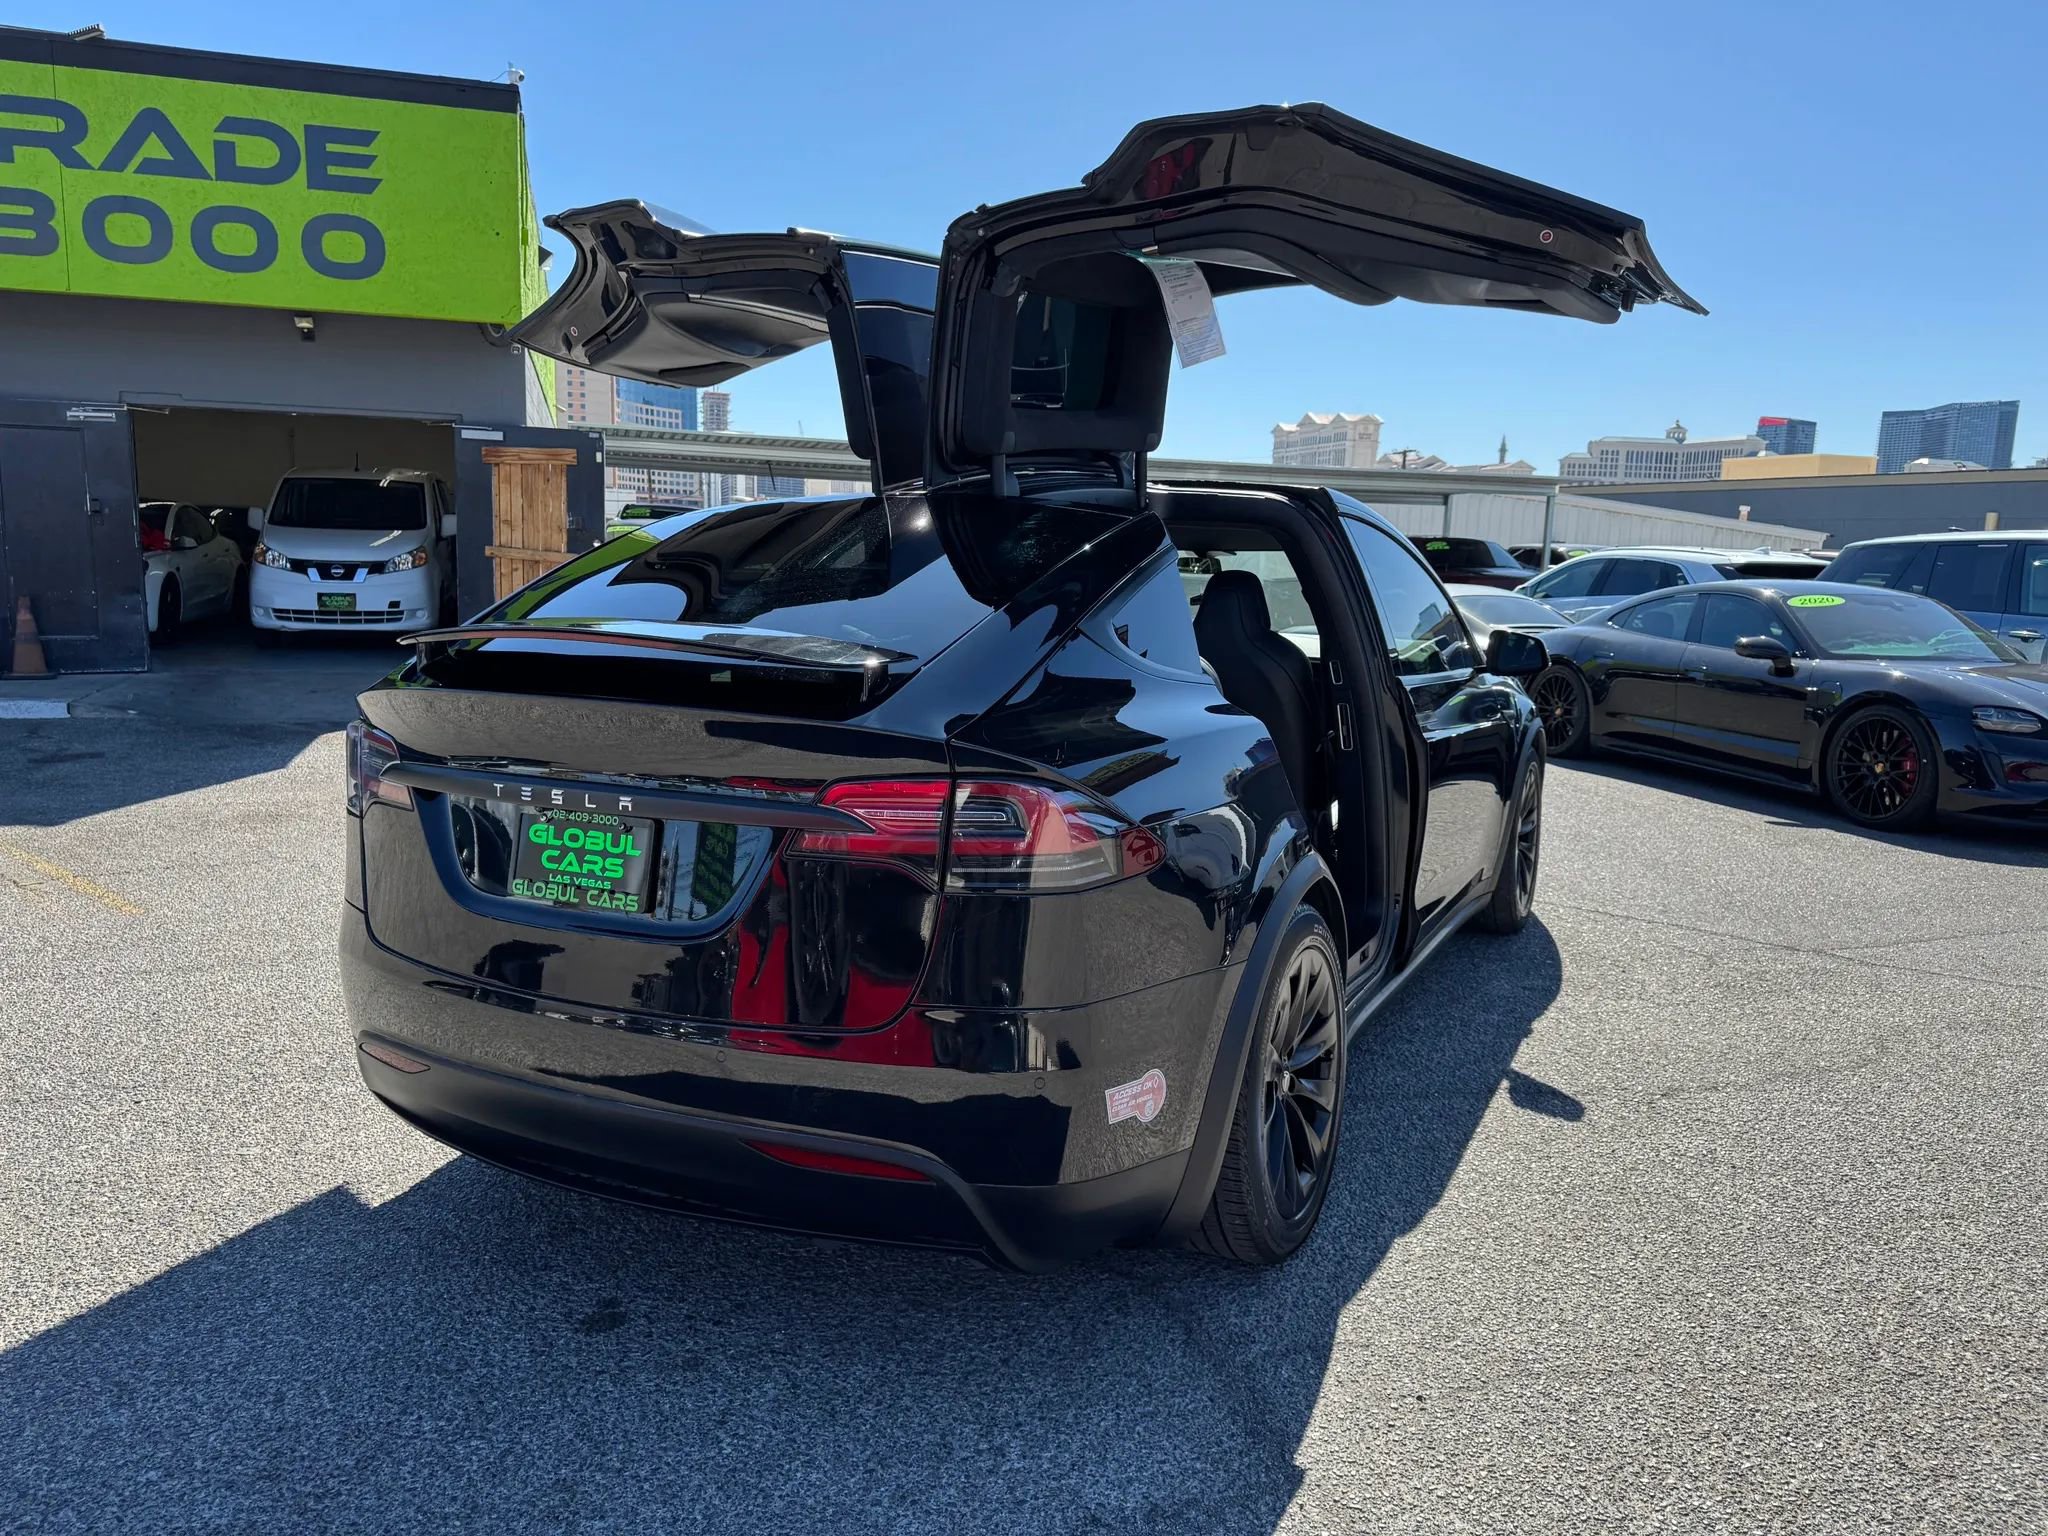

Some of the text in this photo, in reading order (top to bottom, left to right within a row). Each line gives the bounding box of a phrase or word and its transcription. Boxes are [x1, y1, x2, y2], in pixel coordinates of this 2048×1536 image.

[0, 94, 385, 195] RADE
[1799, 597, 1835, 605] 2020
[493, 783, 632, 811] TESLA
[528, 823, 642, 857] GLOBUL
[541, 850, 625, 879] CARS
[512, 878, 639, 912] GLOBUL CARS
[549, 873, 612, 890] LAS VEGAS
[1112, 1084, 1142, 1101] ACCESS
